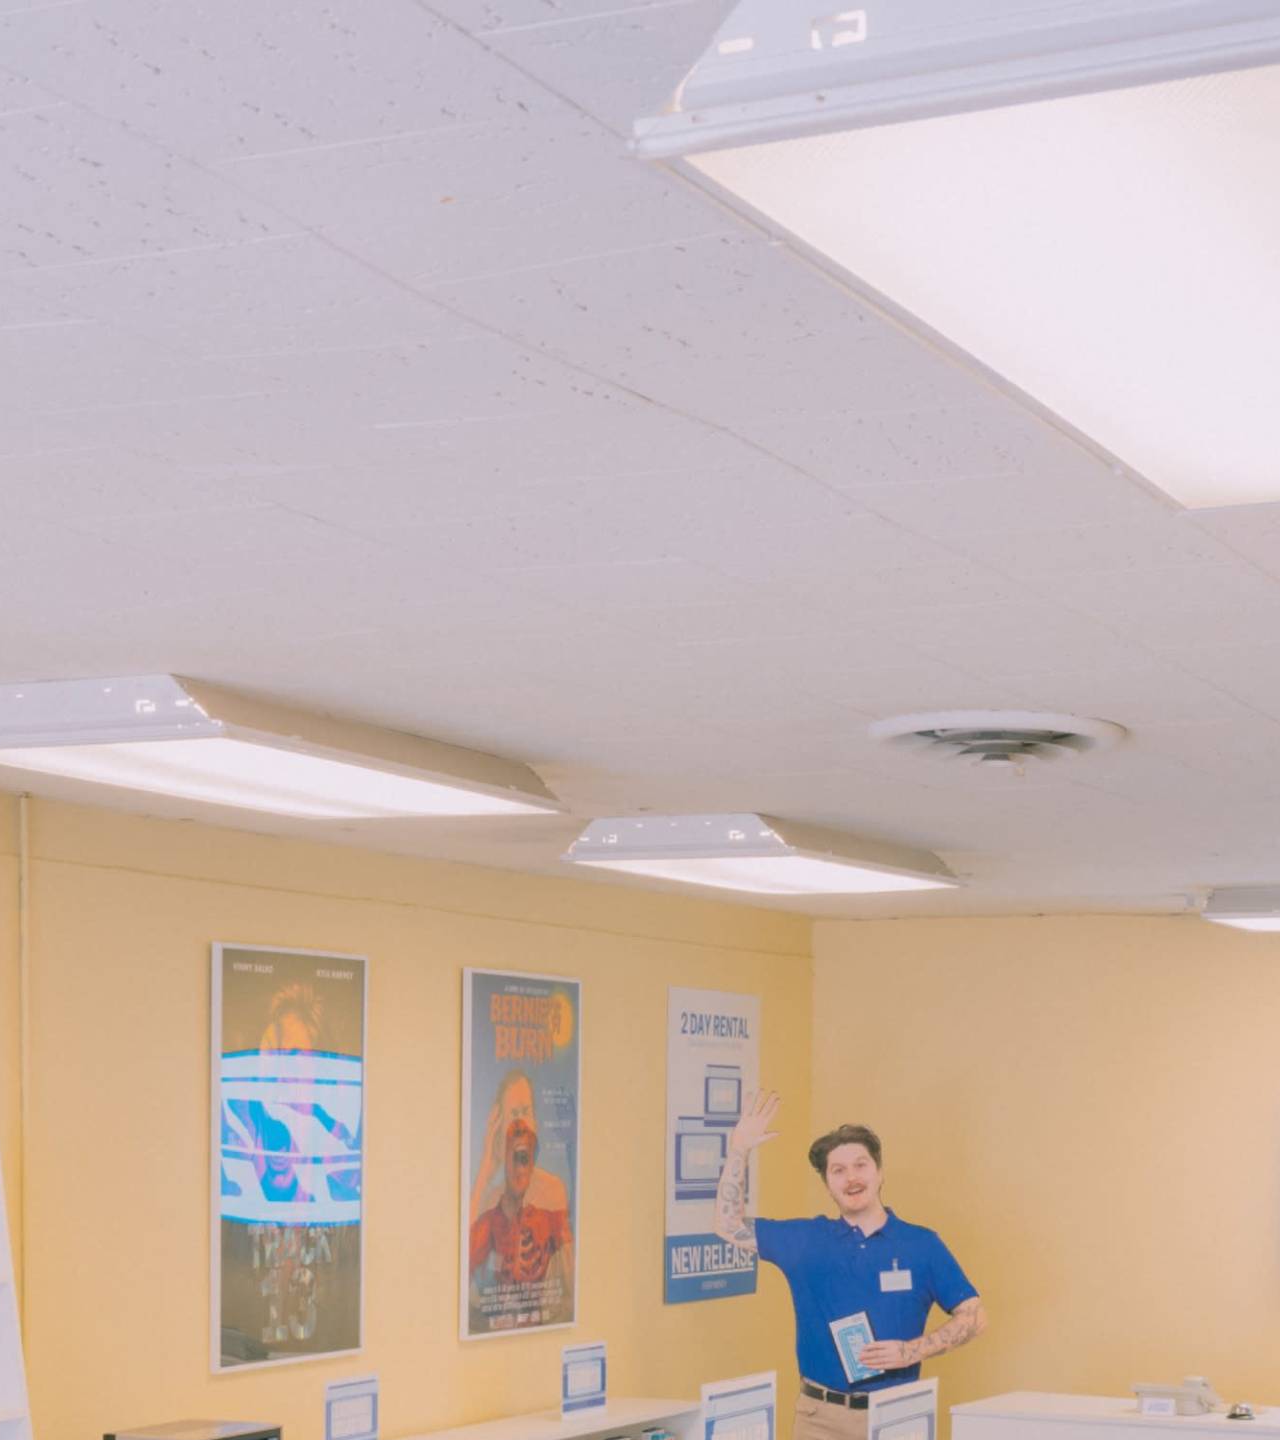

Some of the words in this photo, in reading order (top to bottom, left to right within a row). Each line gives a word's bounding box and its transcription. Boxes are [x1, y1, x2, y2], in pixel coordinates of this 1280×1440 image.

[681, 1012, 688, 1034] 2
[690, 1013, 710, 1035] DAY
[713, 1016, 749, 1038] RENTAL
[671, 1246, 701, 1274] NEW
[704, 1240, 754, 1269] RELEASE
